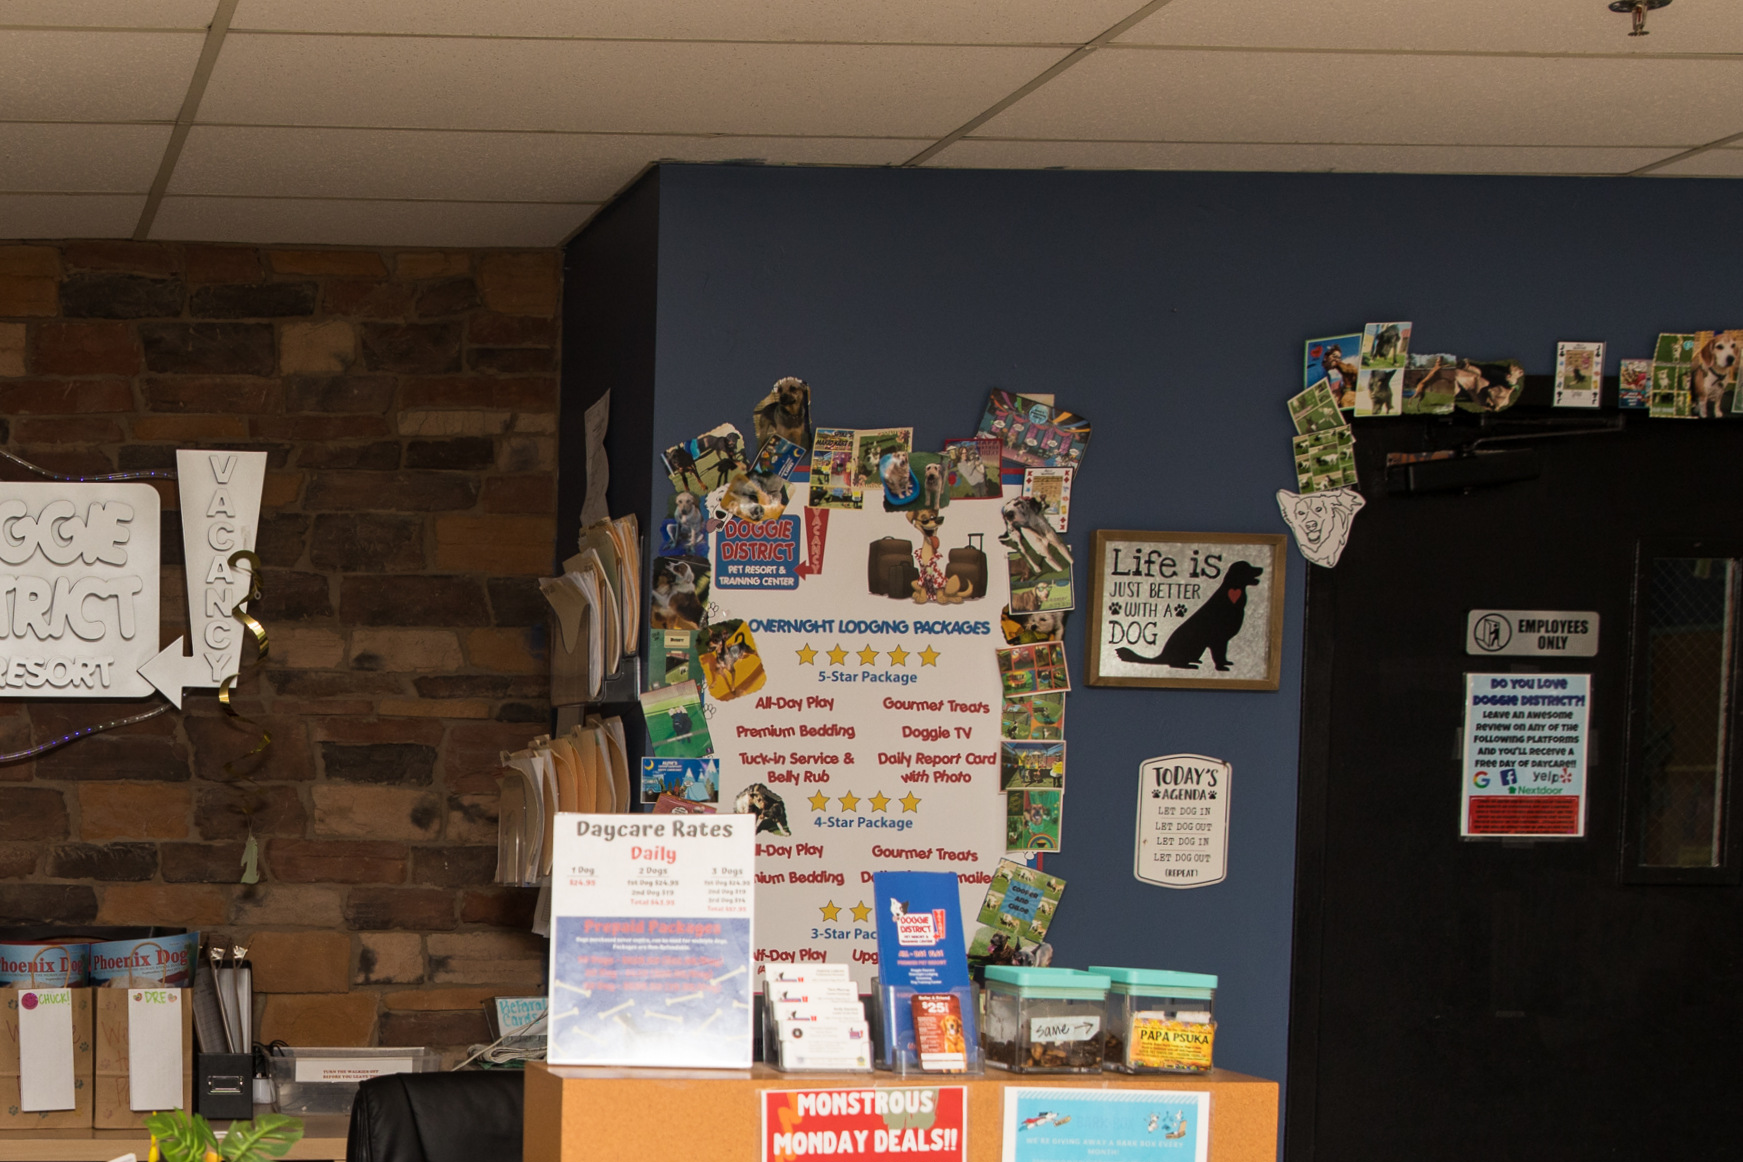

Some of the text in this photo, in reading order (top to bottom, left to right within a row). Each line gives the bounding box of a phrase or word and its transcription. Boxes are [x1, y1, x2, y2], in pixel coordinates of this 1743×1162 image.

[724, 519, 793, 539] DOGGIE
[810, 508, 822, 574] VACANCY
[721, 542, 795, 561] DISTRICT
[204, 454, 239, 684] VACANCY
[728, 566, 786, 574] PET RESORT &
[1111, 548, 1178, 578] Life
[719, 577, 794, 586] TRAINING CENTER
[1109, 582, 1201, 599] JUST BETTER
[1124, 602, 1173, 617] WITH A
[747, 618, 991, 635] OVERNIGHT LODGING PACKAGES
[1108, 620, 1158, 646] DOG
[1518, 619, 1588, 634] EMPLOYEES
[1538, 636, 1568, 649] ONLY
[818, 671, 917, 685] 5-Star Package
[755, 696, 835, 712] All-Day Play
[882, 697, 990, 714] Gourmet Treats
[736, 724, 856, 739] Premium Bedding
[902, 726, 972, 742] Doggie TV
[739, 752, 855, 766] Tuck-in Service &
[878, 752, 997, 768] Daily Report Card
[768, 770, 830, 786] Belly Rub
[901, 770, 971, 783] with Photo
[1152, 766, 1218, 787] TODAY'S
[1533, 771, 1559, 784] yelp
[1162, 789, 1206, 800] AGENDA
[1158, 807, 1211, 816] LET DOG IN
[576, 820, 733, 841] Daycare Rates
[814, 817, 913, 831] 4-Star Package
[1156, 822, 1212, 831] LET DOG OUT
[1157, 837, 1209, 846] LET DOG IN
[631, 846, 676, 864] Daily
[755, 843, 824, 859] ll-Day Play
[872, 845, 978, 862] Gourmet Treats
[1154, 853, 1211, 862] LET DOG OUT
[578, 867, 595, 875] Dog
[646, 867, 668, 875] Dogs
[722, 868, 743, 876] Dogs
[789, 871, 845, 885] Bedding
[1165, 868, 1198, 877] (REPEAT)
[584, 919, 721, 937] Prepaid Packages
[811, 928, 851, 939] 3-Star
[94, 949, 188, 970] Phoenix Dog
[799, 948, 827, 963] Play
[60, 957, 84, 975] Dog
[38, 991, 70, 1005] CHUCK!
[144, 991, 166, 1003] DRE
[1035, 1023, 1070, 1038] same
[1140, 1029, 1209, 1045] PAPA PSUKA
[797, 1091, 933, 1116] MONSTROUS
[773, 1128, 958, 1156] MONDAY DEALS!!
